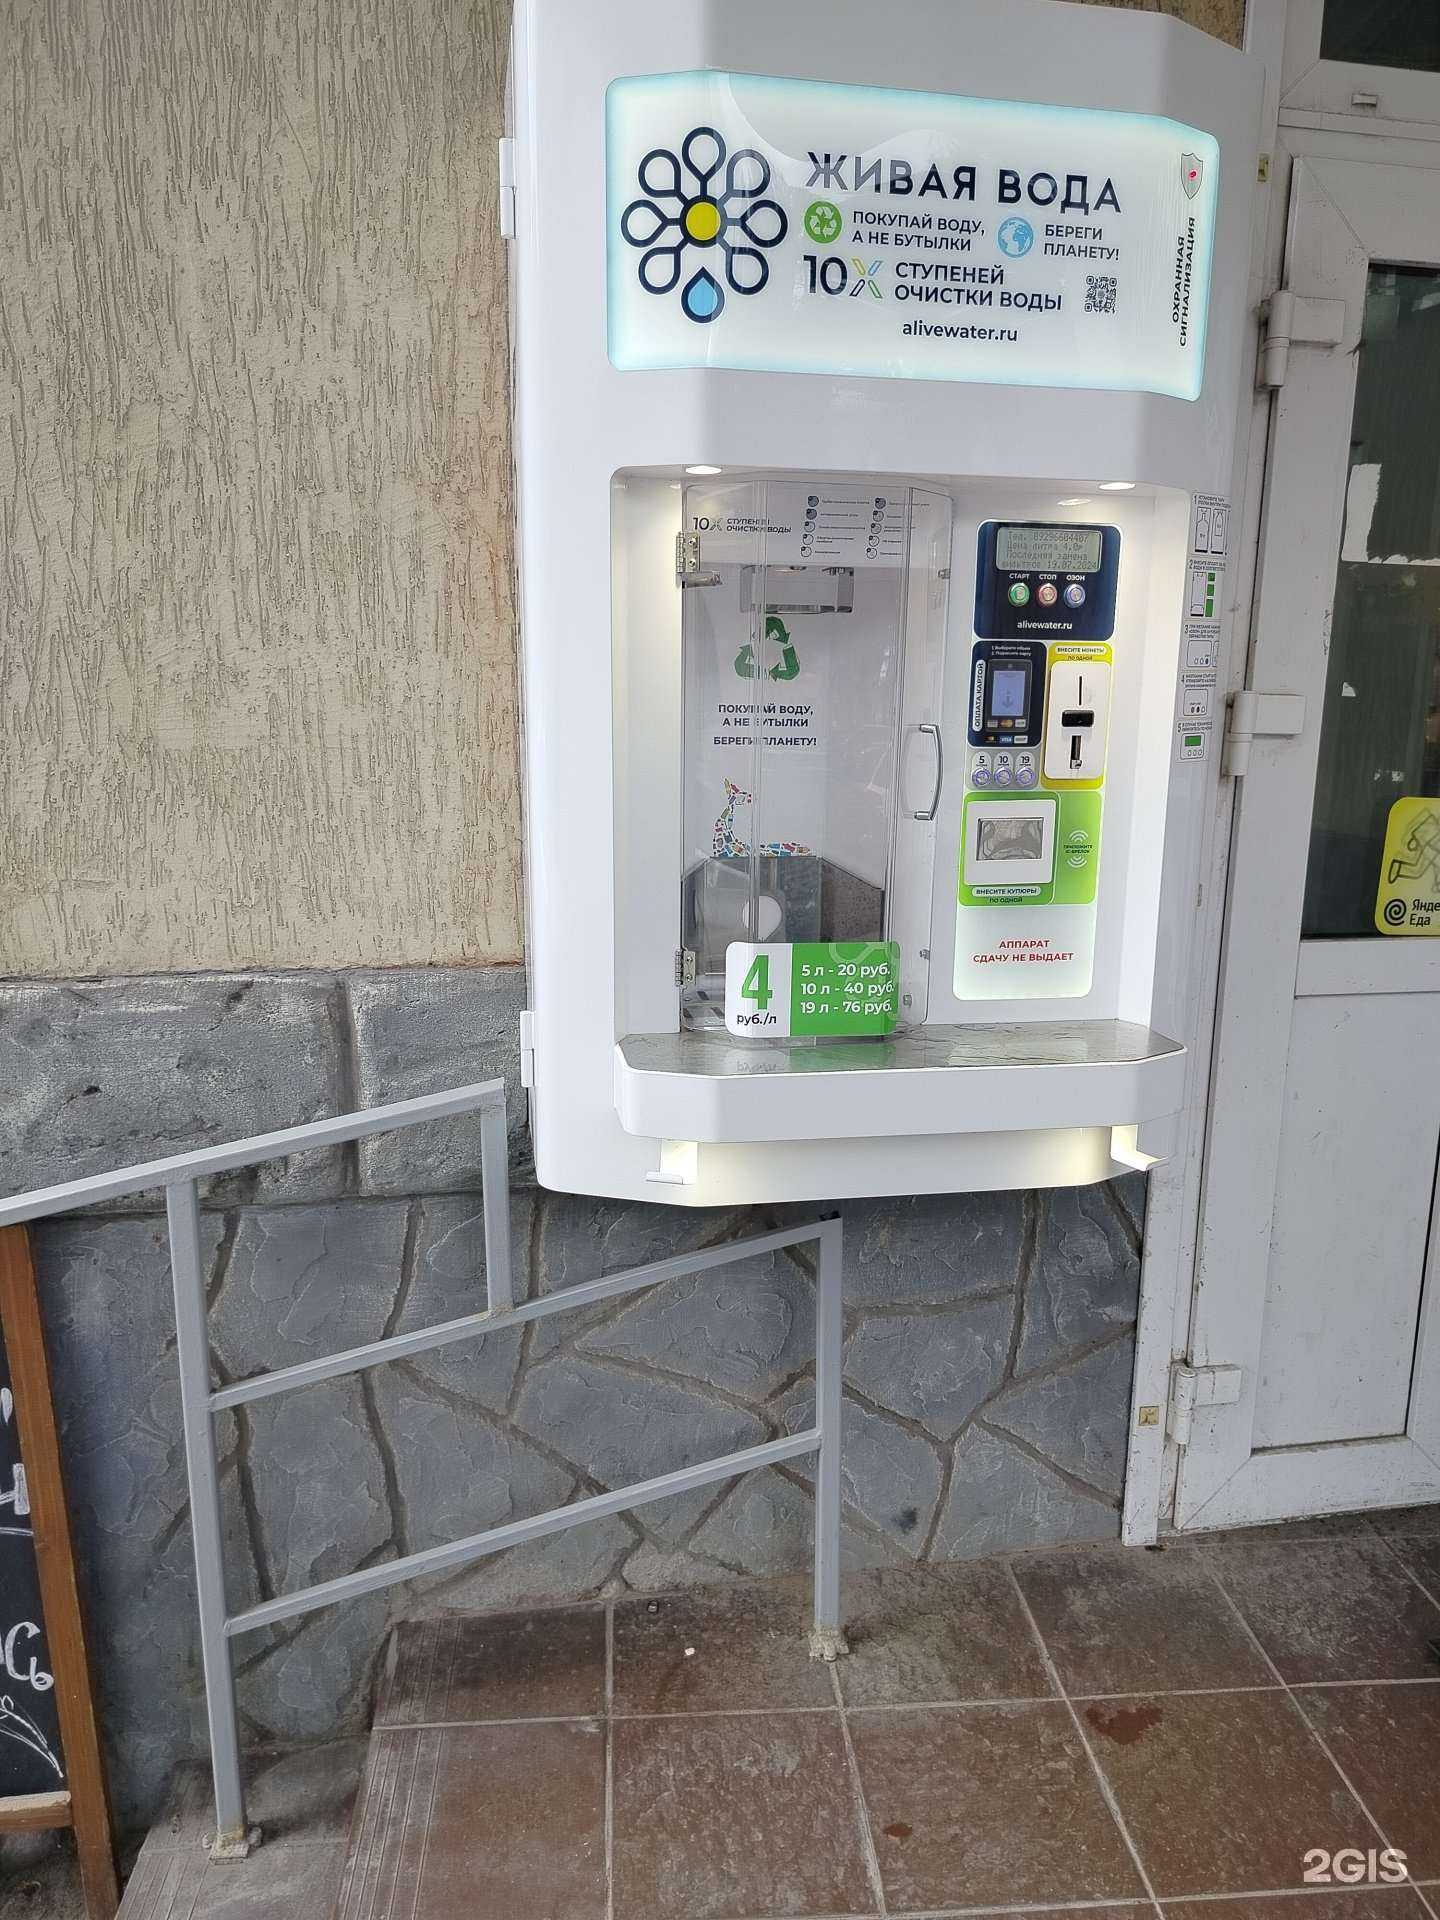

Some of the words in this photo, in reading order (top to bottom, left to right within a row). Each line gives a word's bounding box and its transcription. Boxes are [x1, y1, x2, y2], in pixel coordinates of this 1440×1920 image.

[805, 151, 977, 202] ЖИВАЯ
[997, 168, 1122, 216] ВОДА
[852, 210, 933, 229] ПОКУПАЙ
[937, 217, 986, 237] ВОДУ,
[1044, 224, 1103, 241] БЕРЕГИ
[852, 231, 864, 244] А
[868, 232, 890, 246] НЕ
[894, 234, 971, 252] БУТЫЛКИ
[1043, 243, 1120, 261] ПЛАНЕТУ!
[895, 261, 1005, 285] СТУПЕНЕЙ
[1172, 236, 1185, 323] ОХРАННАЯ
[1179, 217, 1196, 347] СИГНАЛИЗАЦИЯ
[894, 284, 993, 307] ОЧИСТКИ
[1000, 291, 1062, 312] ВОДЫ
[902, 319, 1018, 342] alivewater.ru
[1017, 620, 1073, 630] alivewater.ru
[779, 705, 814, 716] ВОДУ,
[722, 718, 731, 727] А
[734, 718, 750, 727] НЕ
[978, 755, 985, 764] 5
[999, 755, 1009, 764] 10
[1020, 755, 1030, 764] 19
[1409, 913, 1431, 927] Еда
[999, 940, 1050, 949] АППАРАТ
[973, 954, 1009, 963] СДАЧУ
[1012, 954, 1027, 962] НЕ
[1029, 953, 1074, 962] ВЫДАЕТ
[801, 964, 811, 976] 5
[814, 966, 824, 976] л
[837, 963, 857, 976] 20
[860, 962, 890, 978] руб.
[741, 953, 775, 1010] 4
[800, 983, 816, 995] 10
[820, 985, 830, 995] л
[843, 982, 864, 994] 40
[800, 1002, 816, 1014] 19
[819, 1003, 829, 1013] л
[842, 1001, 861, 1013] 76
[737, 1012, 777, 1026] руб./л
